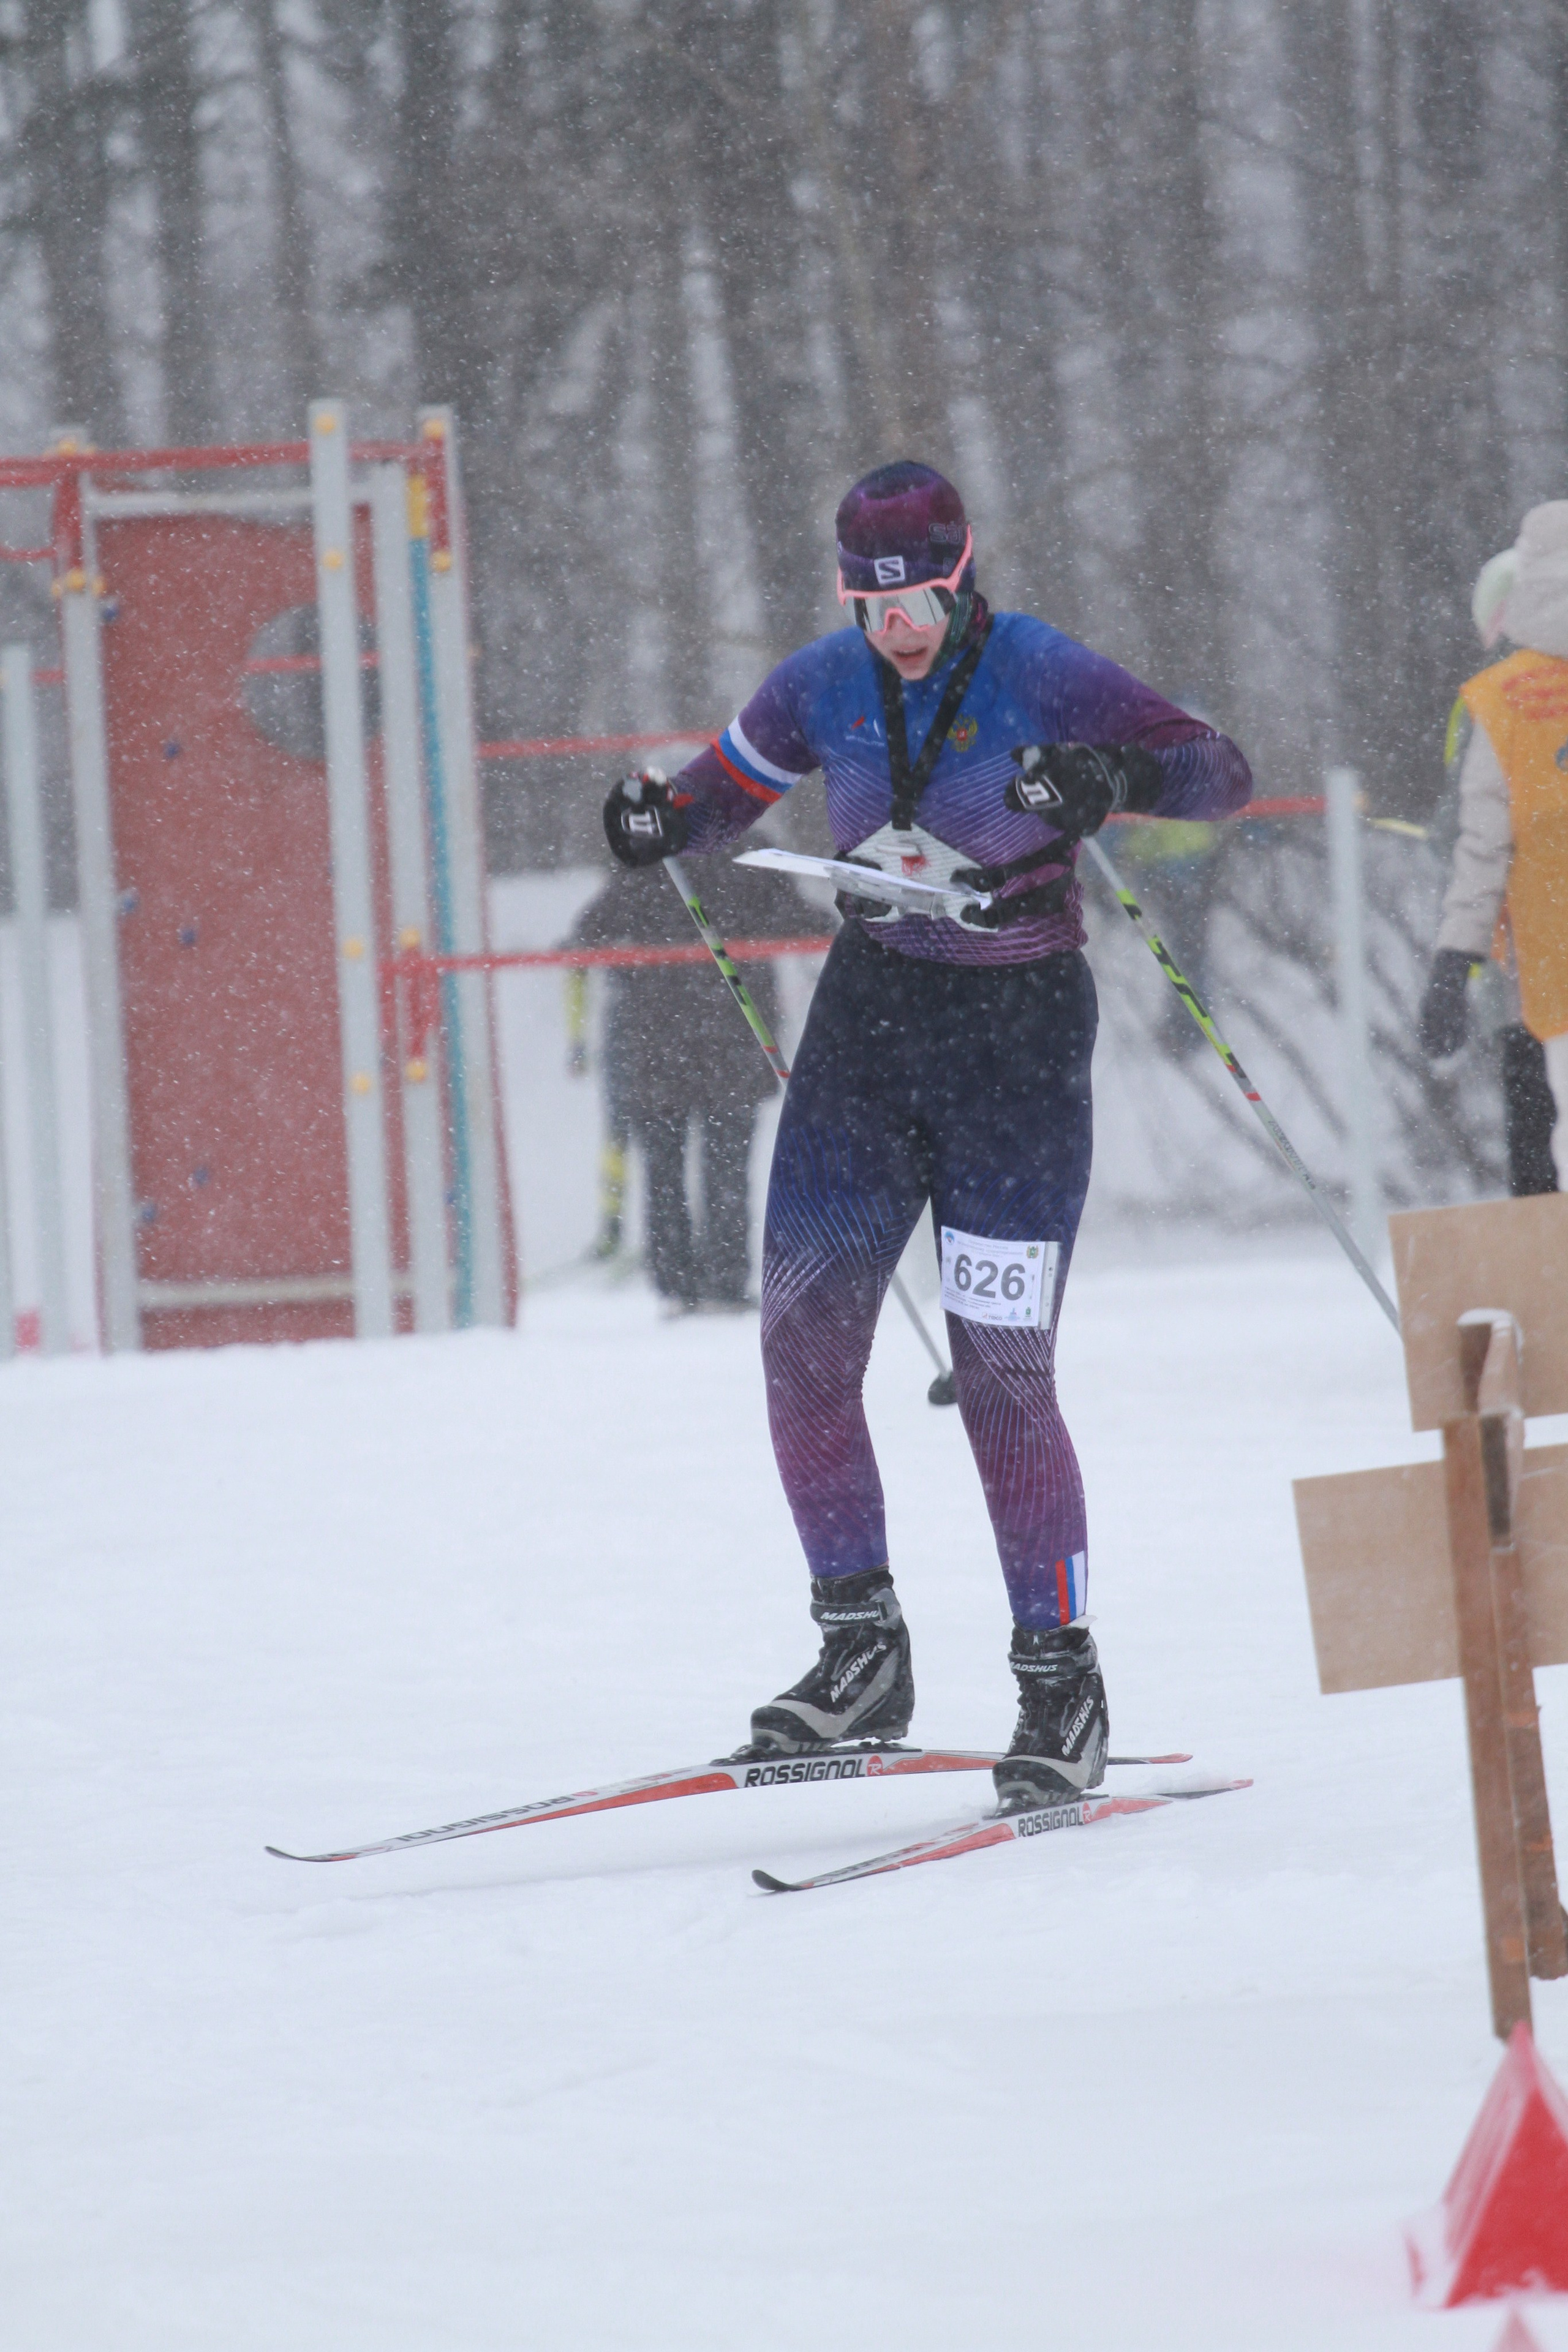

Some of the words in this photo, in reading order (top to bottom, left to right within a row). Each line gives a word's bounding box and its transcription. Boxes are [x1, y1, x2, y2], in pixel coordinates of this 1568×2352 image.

[954, 1254, 1026, 1301] 626
[820, 1610, 879, 1621] MADSHU
[829, 1643, 887, 1703] MADSHUS
[1061, 1695, 1094, 1755] MADSHUS
[745, 1758, 865, 1788] ROSSIGNOL
[1018, 1807, 1084, 1838] ROSSIGNOL
